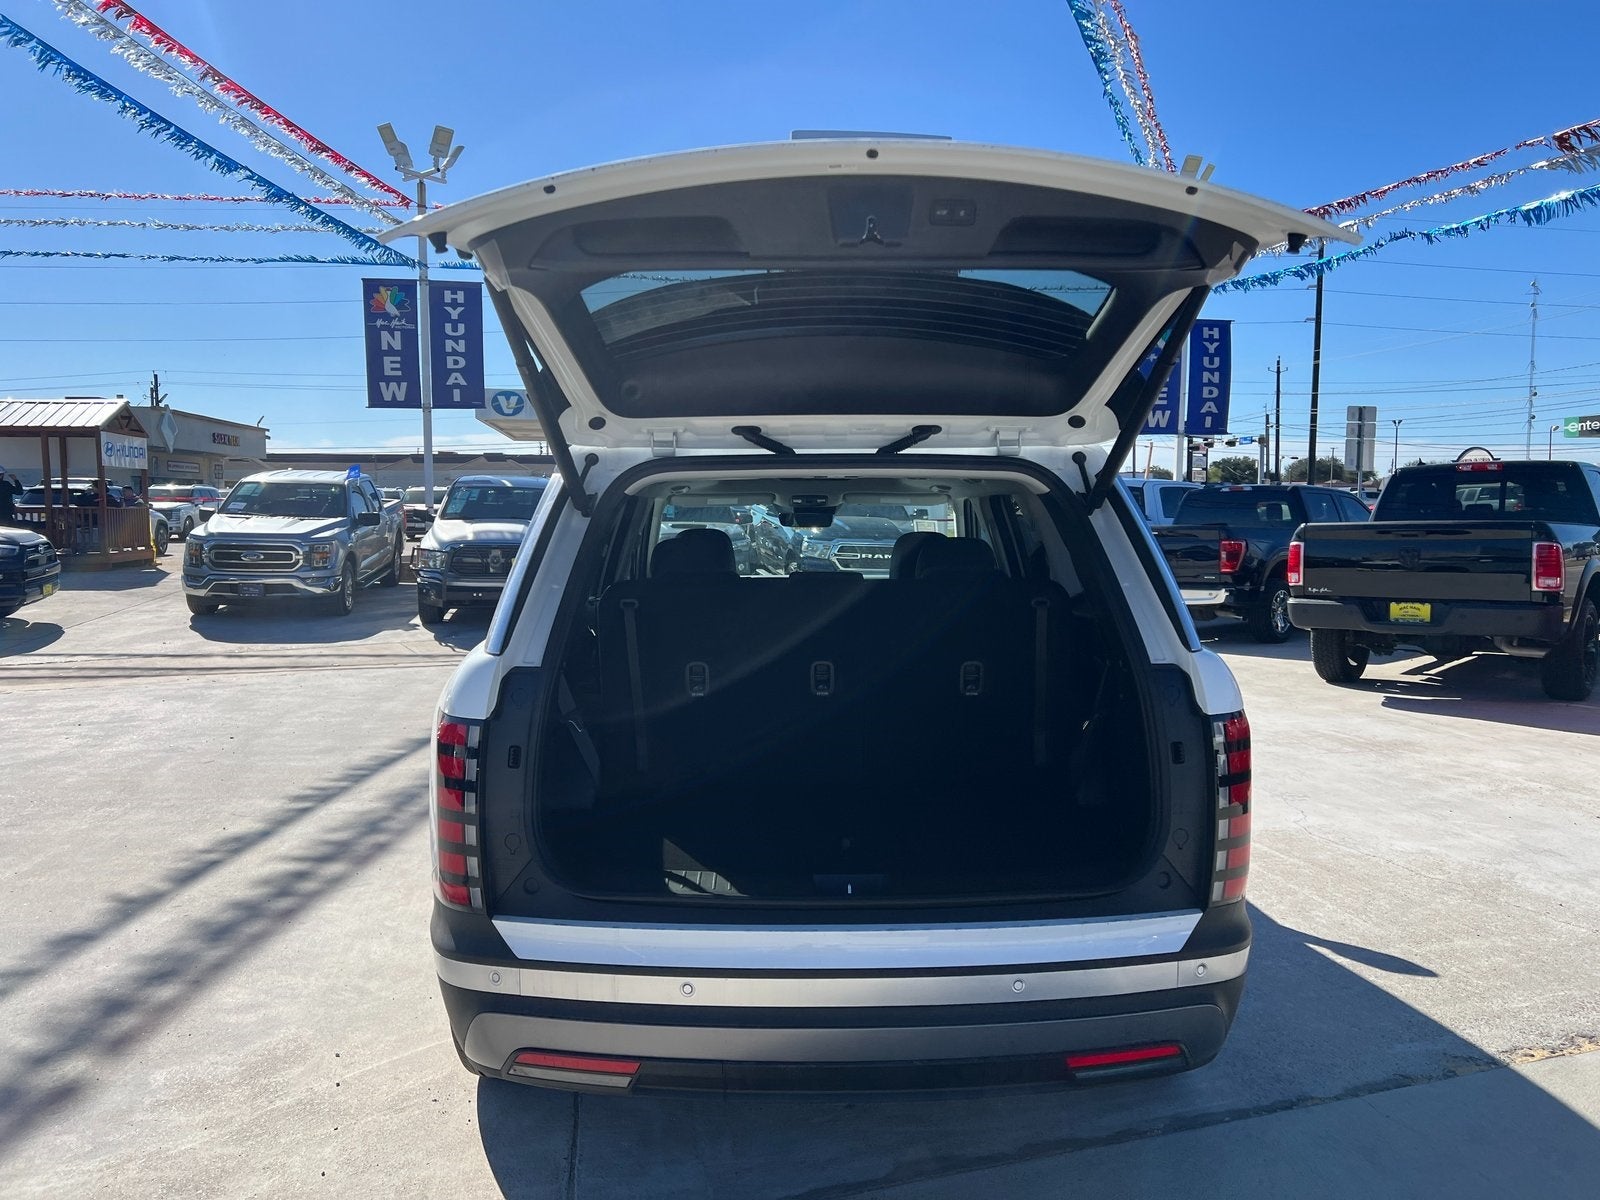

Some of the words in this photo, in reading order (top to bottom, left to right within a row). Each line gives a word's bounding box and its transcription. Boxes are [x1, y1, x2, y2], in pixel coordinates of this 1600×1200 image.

[379, 330, 408, 402] NEW
[443, 290, 468, 402] HYUNDAI
[1200, 327, 1220, 428] HYUNDAI
[1146, 377, 1171, 428] EW
[115, 444, 146, 459] HYUNDAI
